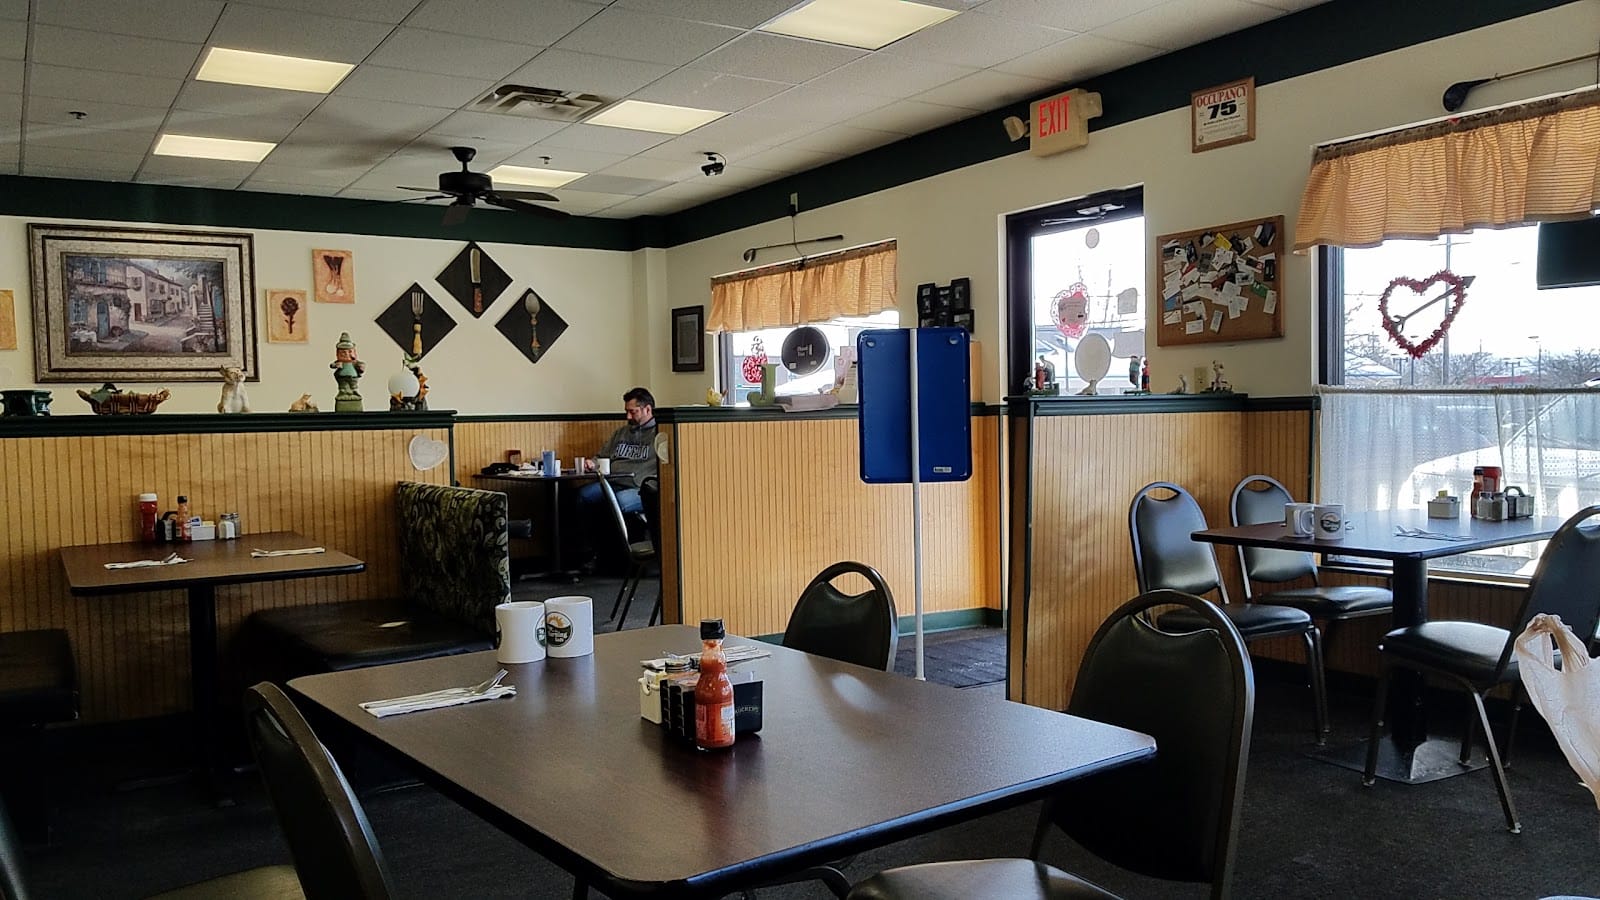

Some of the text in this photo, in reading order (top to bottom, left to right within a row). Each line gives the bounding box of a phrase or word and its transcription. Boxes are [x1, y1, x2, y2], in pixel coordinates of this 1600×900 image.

[1196, 85, 1247, 108] OCCUPANCY
[1039, 95, 1070, 138] EXIT
[1207, 99, 1237, 120] 75
